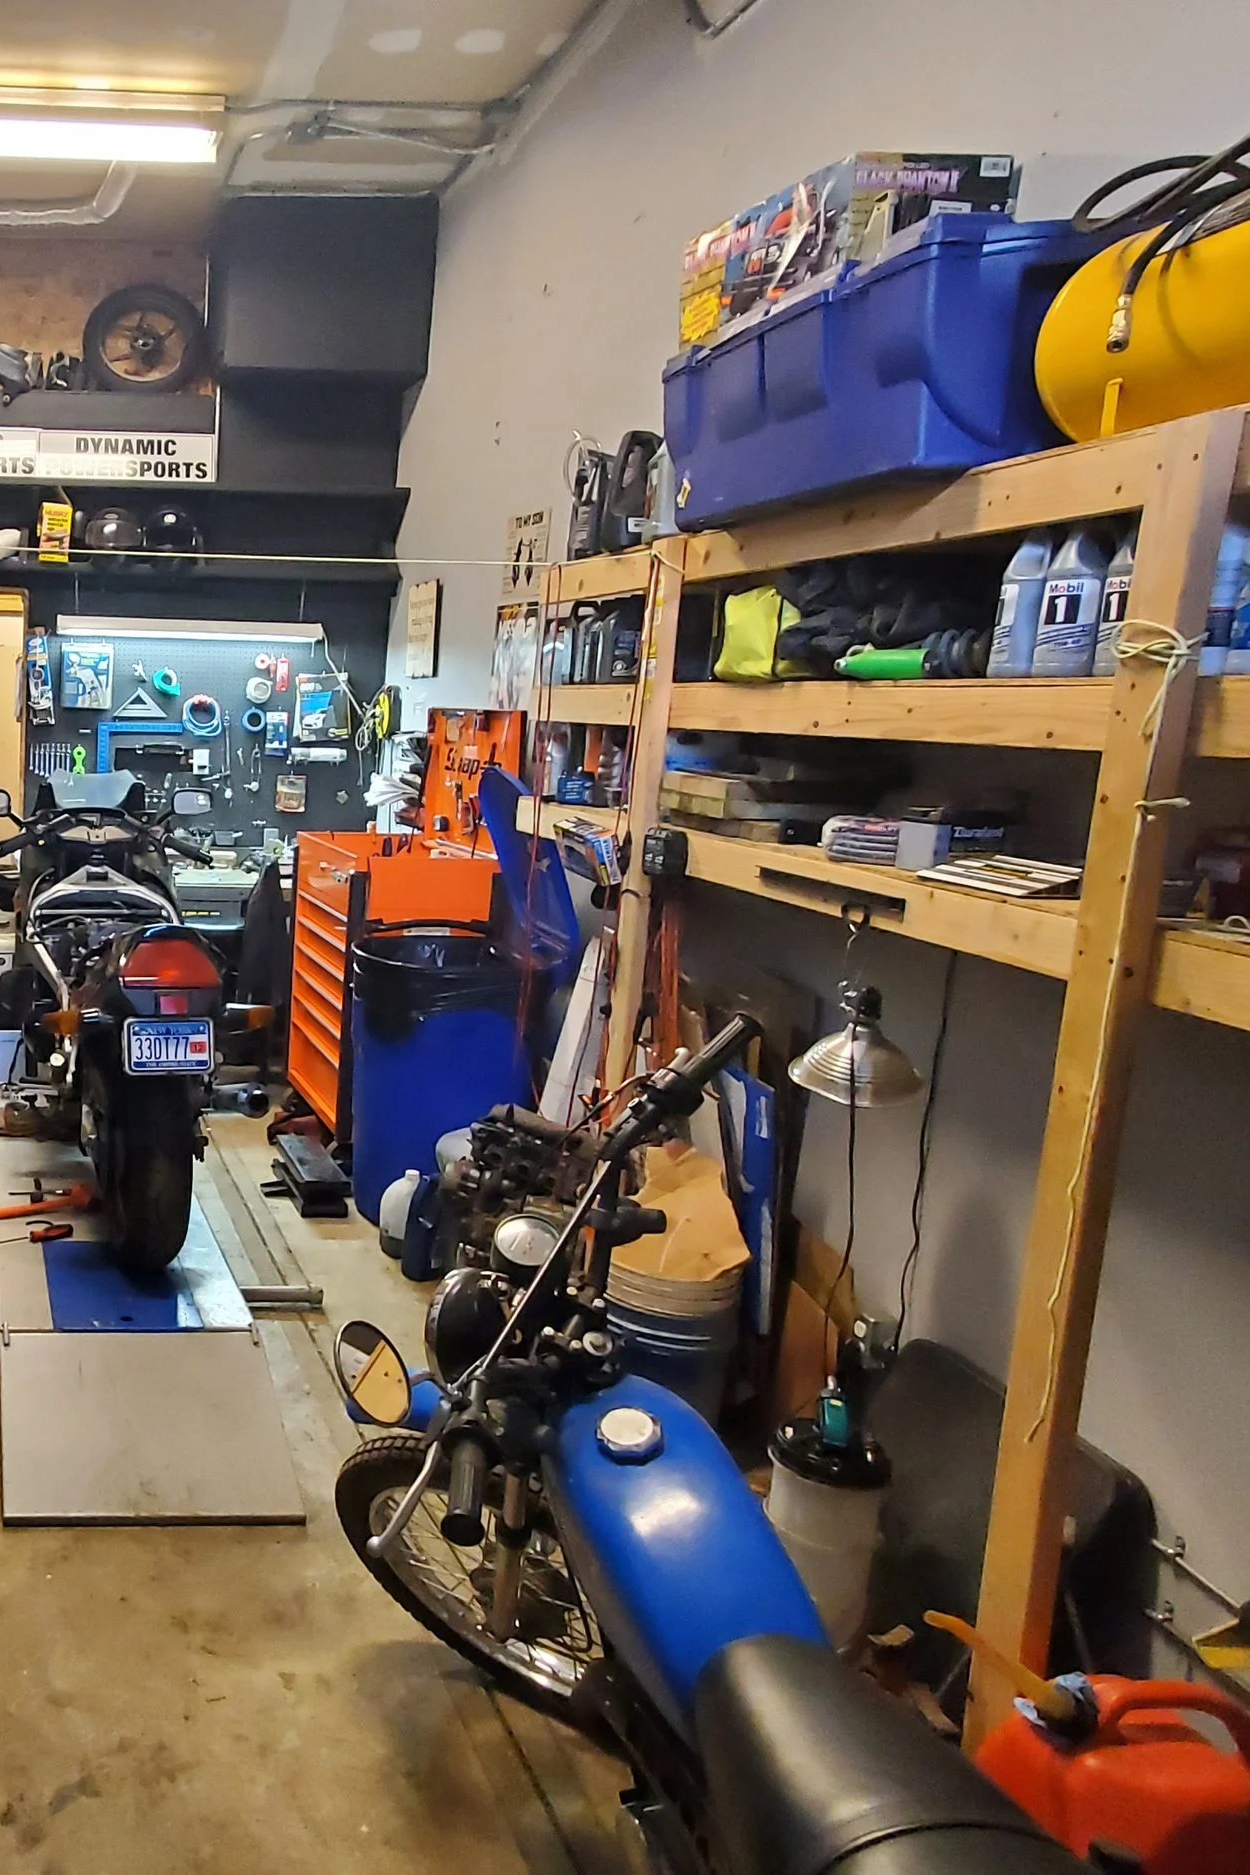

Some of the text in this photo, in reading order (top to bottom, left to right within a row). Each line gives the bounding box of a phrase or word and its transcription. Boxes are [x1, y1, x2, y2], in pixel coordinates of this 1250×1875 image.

[76, 437, 177, 456] DYNAMIC
[45, 459, 207, 479] POWERSPORTS
[1049, 582, 1084, 594] Mobil
[1054, 596, 1068, 623] 1
[1109, 592, 1121, 622] 1
[135, 1037, 189, 1060] 33DT77
